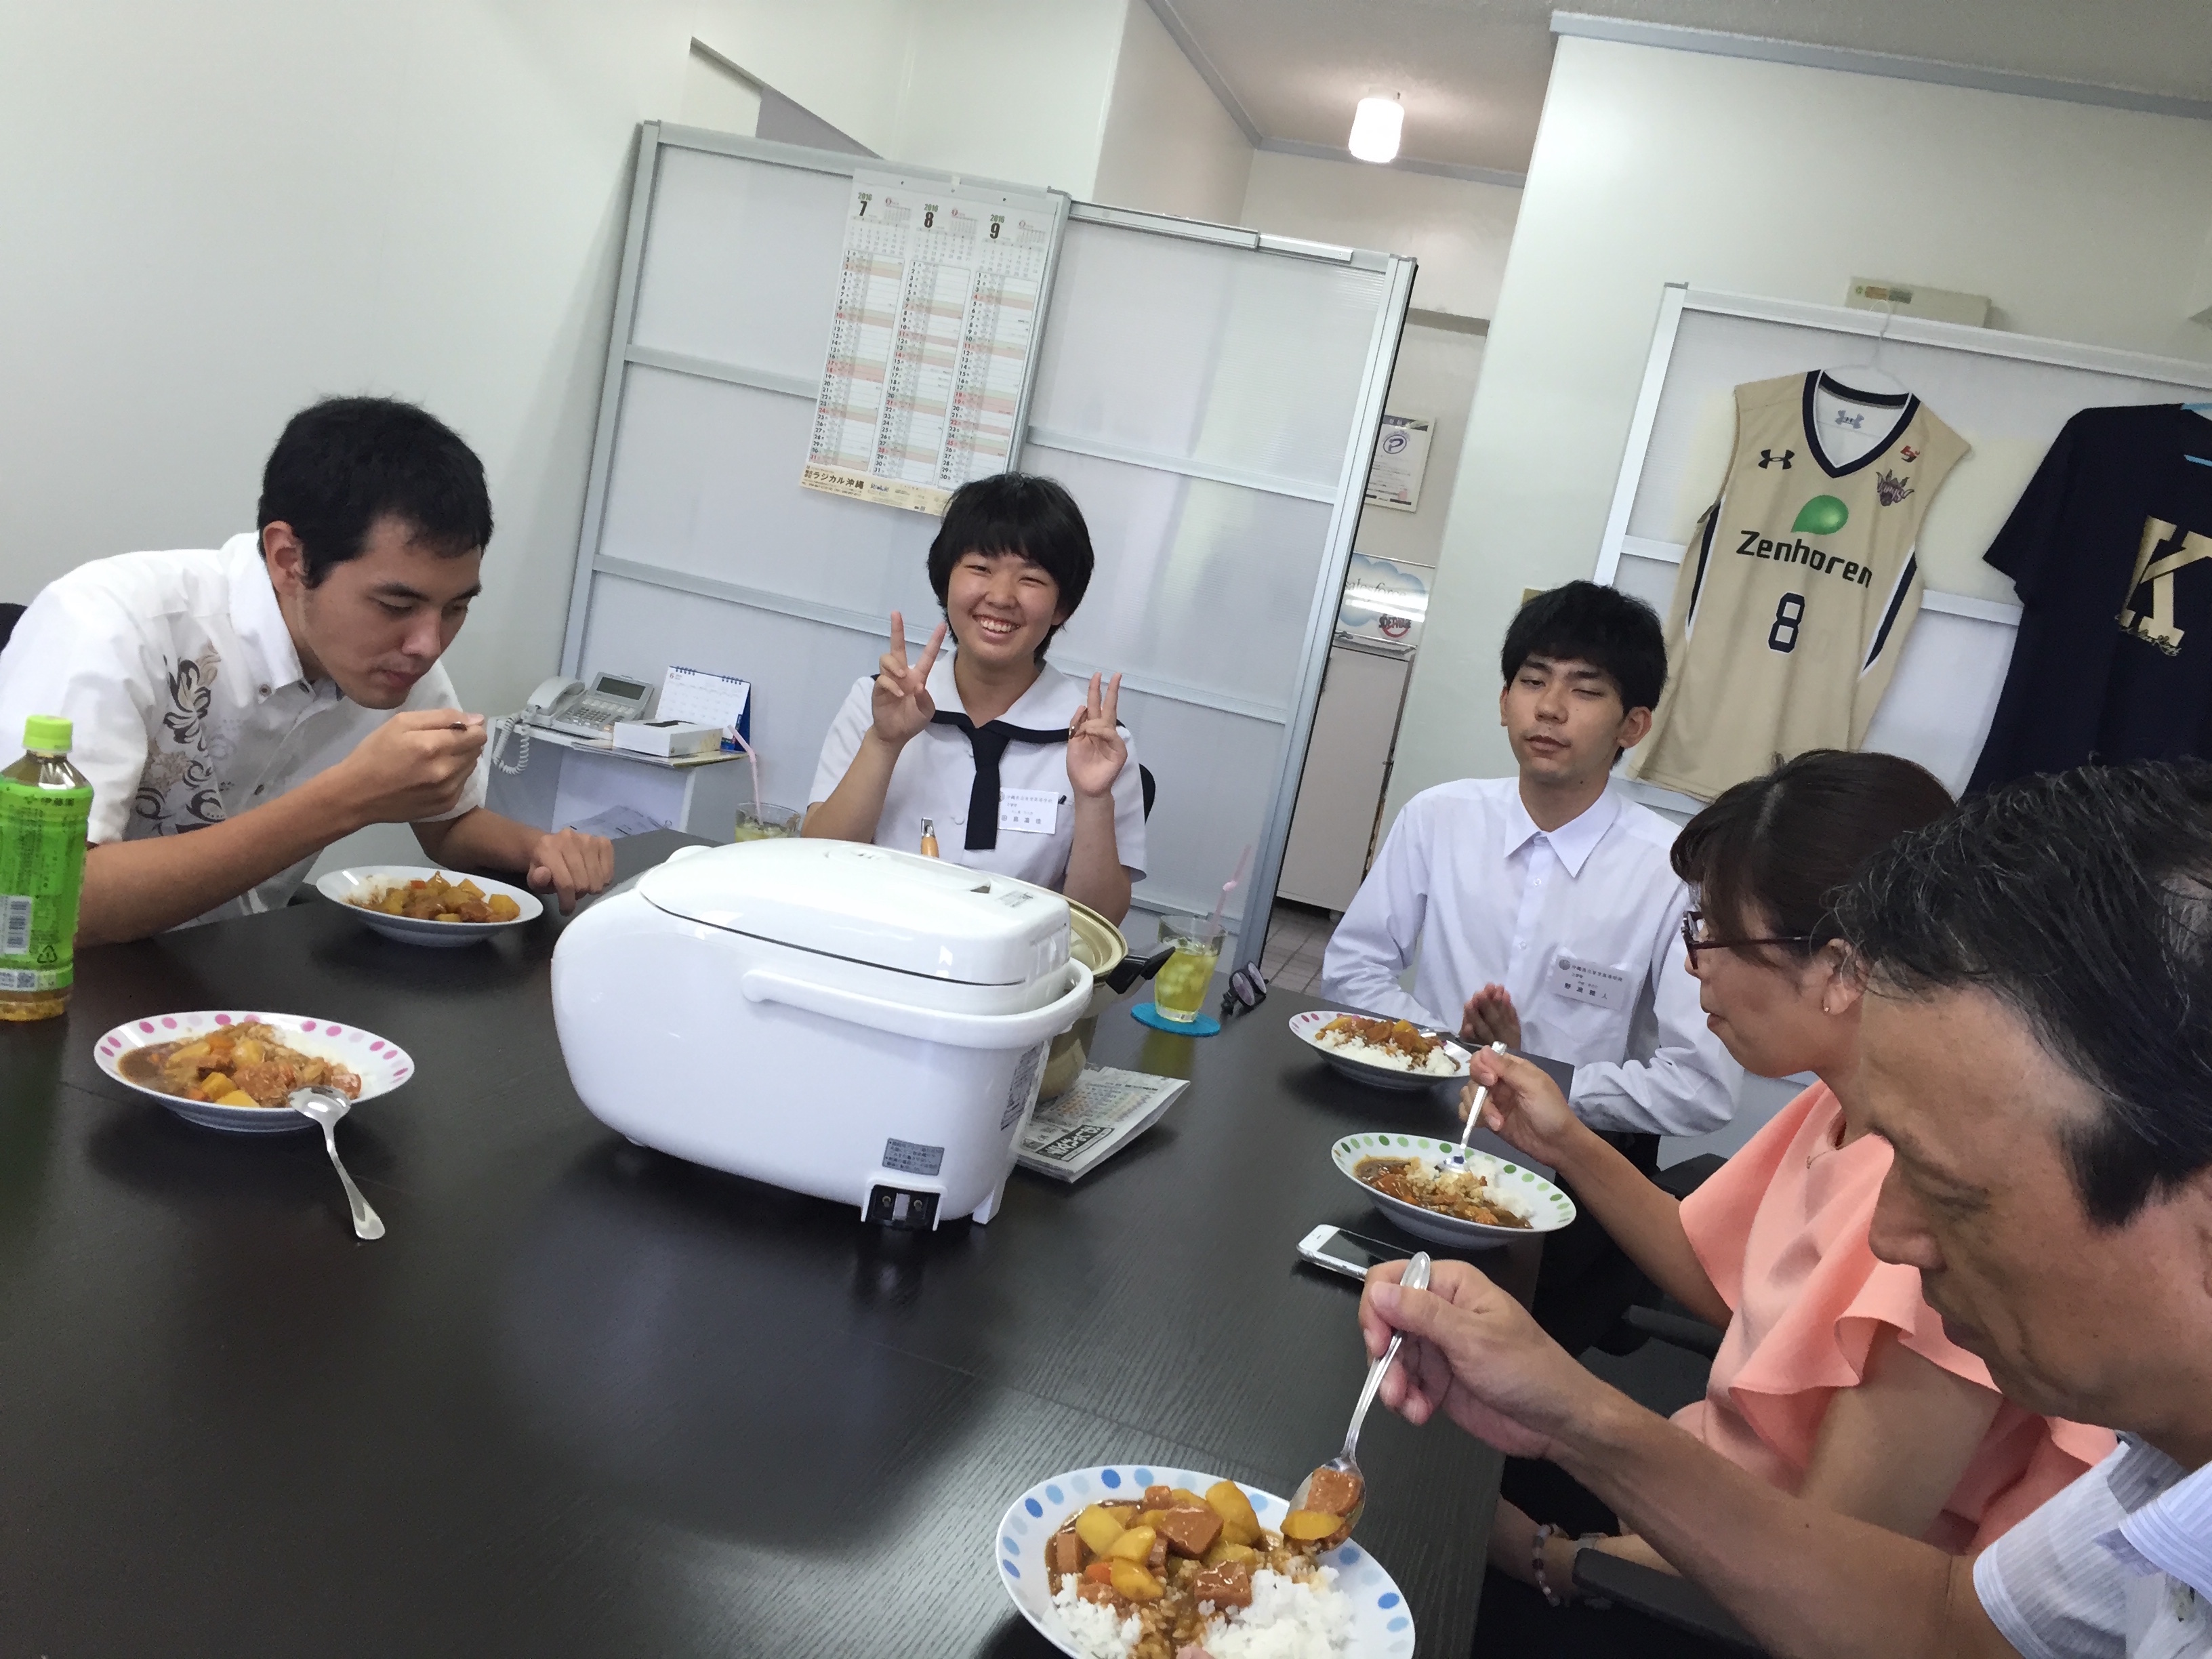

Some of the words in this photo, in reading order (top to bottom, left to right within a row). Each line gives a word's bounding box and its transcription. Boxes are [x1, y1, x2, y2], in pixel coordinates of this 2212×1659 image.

[859, 201, 867, 216] 7
[924, 211, 934, 228] 8
[989, 222, 1000, 239] 9
[1736, 530, 1872, 588] Zenhoren
[1768, 592, 1805, 653] 8
